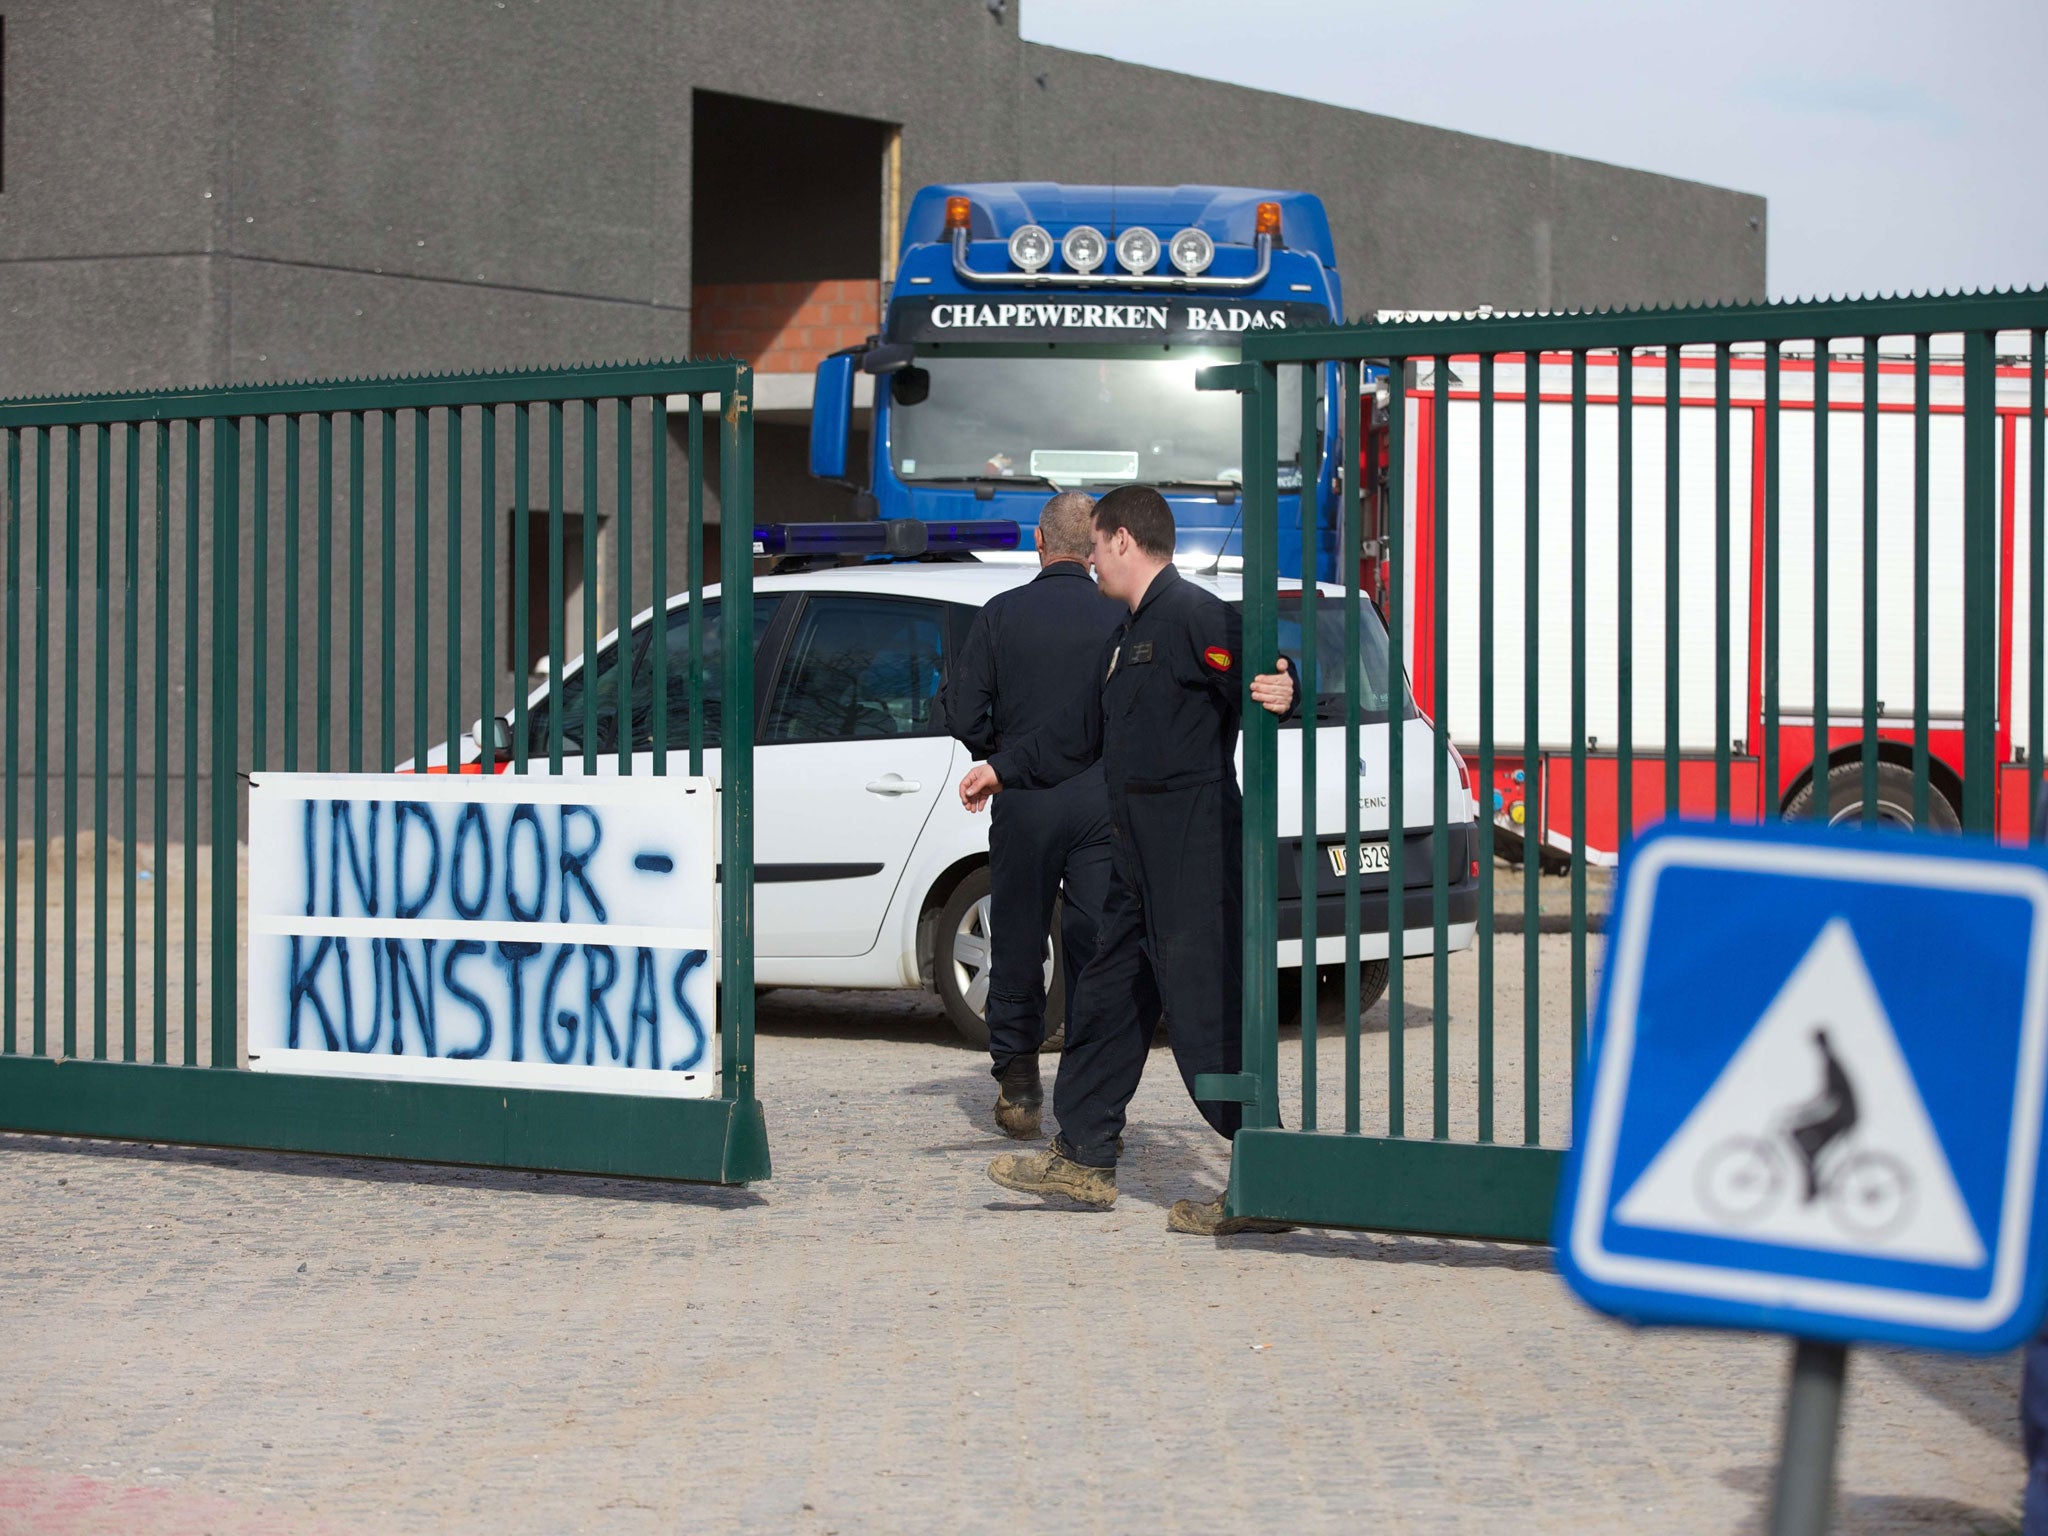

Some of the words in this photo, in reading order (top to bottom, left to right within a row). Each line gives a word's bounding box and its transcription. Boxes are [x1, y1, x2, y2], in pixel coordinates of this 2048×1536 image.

[931, 304, 1169, 329] CHAPEWERKEN
[1186, 307, 1287, 332] BADAS
[1358, 797, 1387, 809] CENIC
[1343, 846, 1390, 868] 529
[288, 935, 708, 1072] KUNSTGRAS
